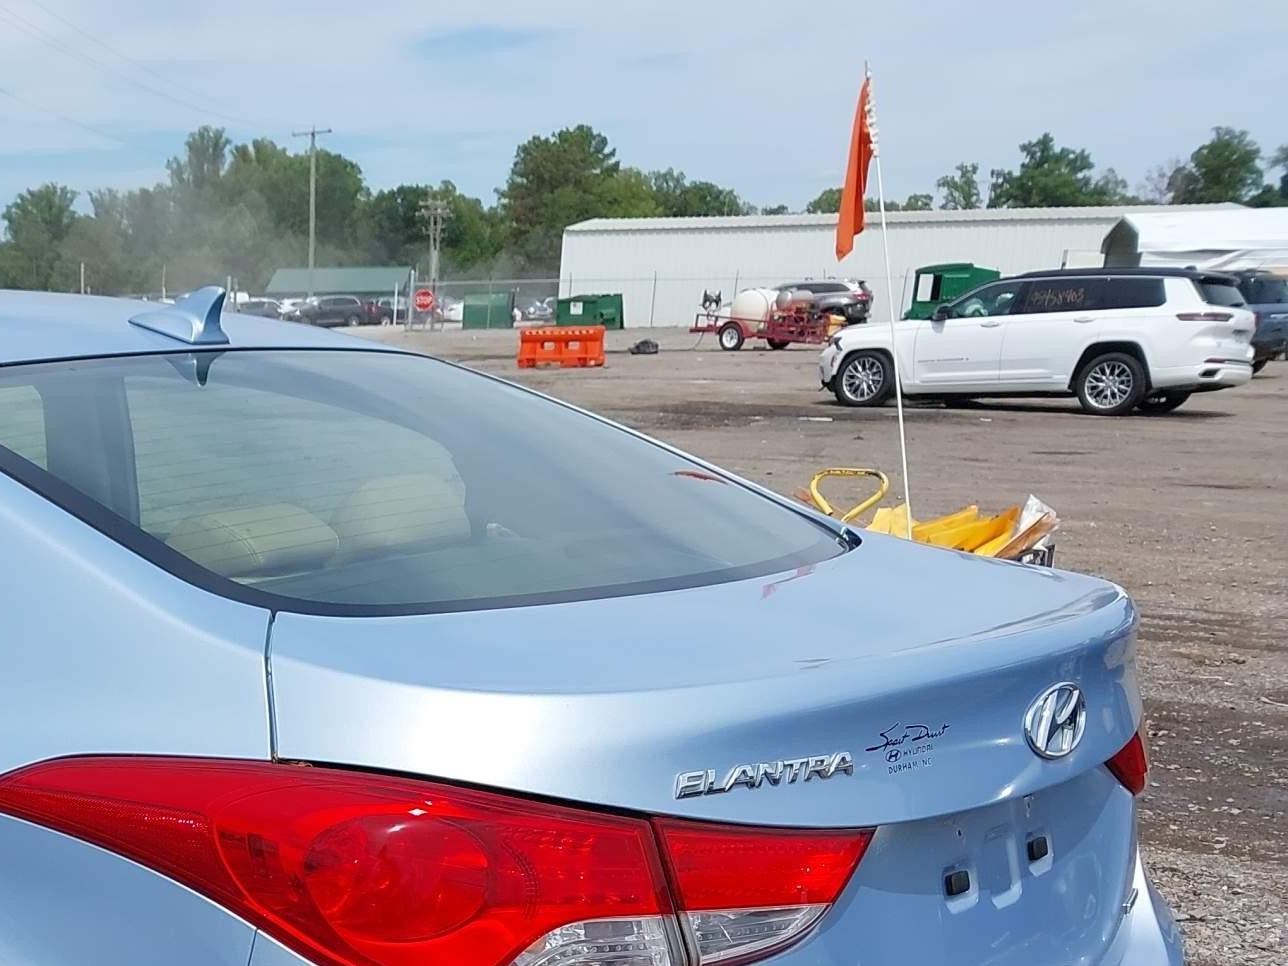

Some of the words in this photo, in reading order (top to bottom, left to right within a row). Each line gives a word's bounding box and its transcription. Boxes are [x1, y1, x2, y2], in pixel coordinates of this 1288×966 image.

[904, 744, 933, 756] HYUNDAI
[888, 761, 918, 774] DURHAM
[675, 751, 856, 799] ELANTRA
